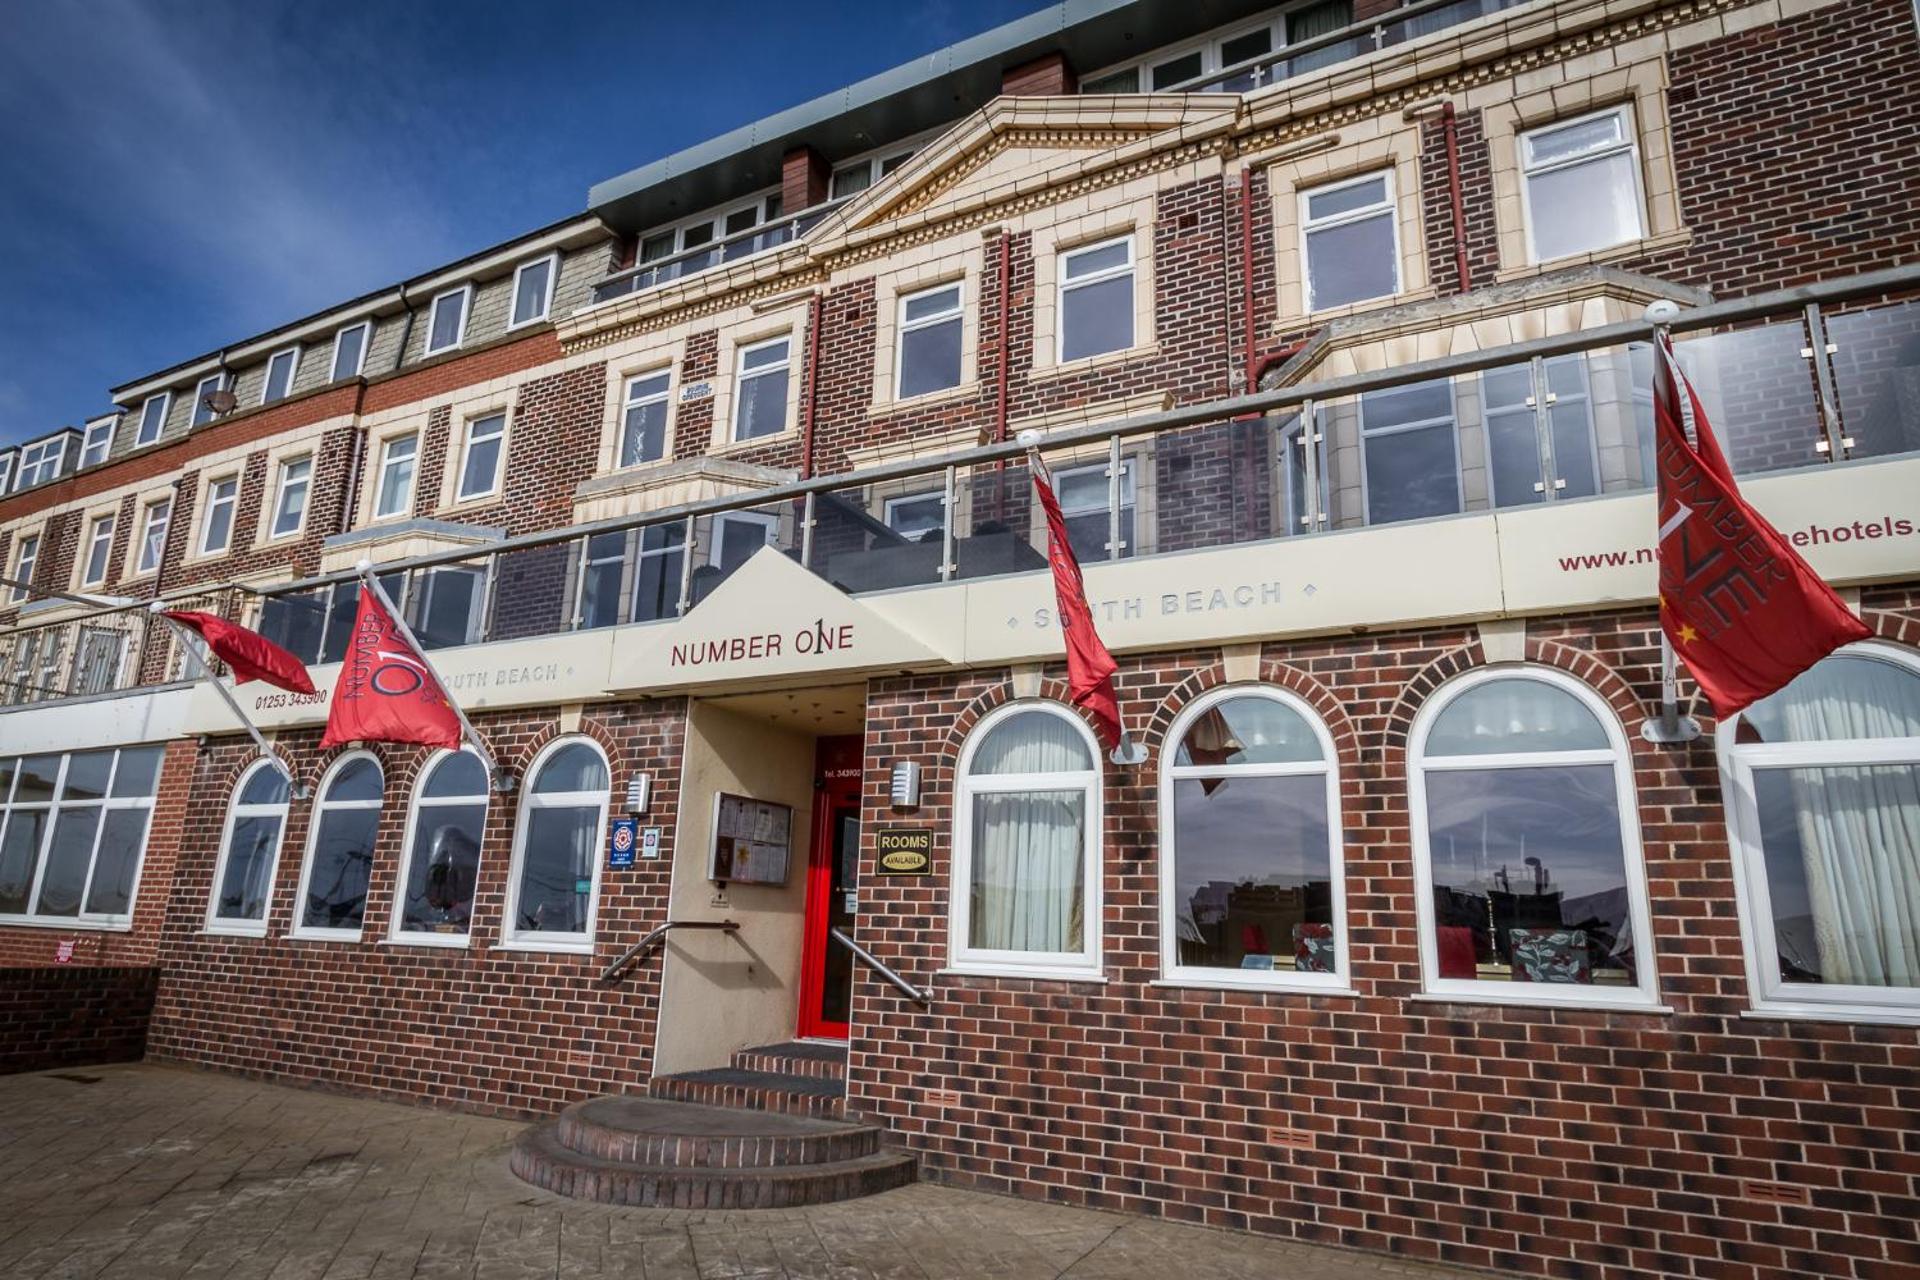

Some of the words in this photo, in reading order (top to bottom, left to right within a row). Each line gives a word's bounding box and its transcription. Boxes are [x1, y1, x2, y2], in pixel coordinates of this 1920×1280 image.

[1033, 598, 1142, 629] STH
[1161, 581, 1281, 616] BEACH
[671, 634, 782, 667] NUMBER
[443, 671, 488, 689] OUTH
[496, 663, 558, 686] BEACH
[255, 694, 287, 710] 01253
[881, 835, 929, 848] ROOMS
